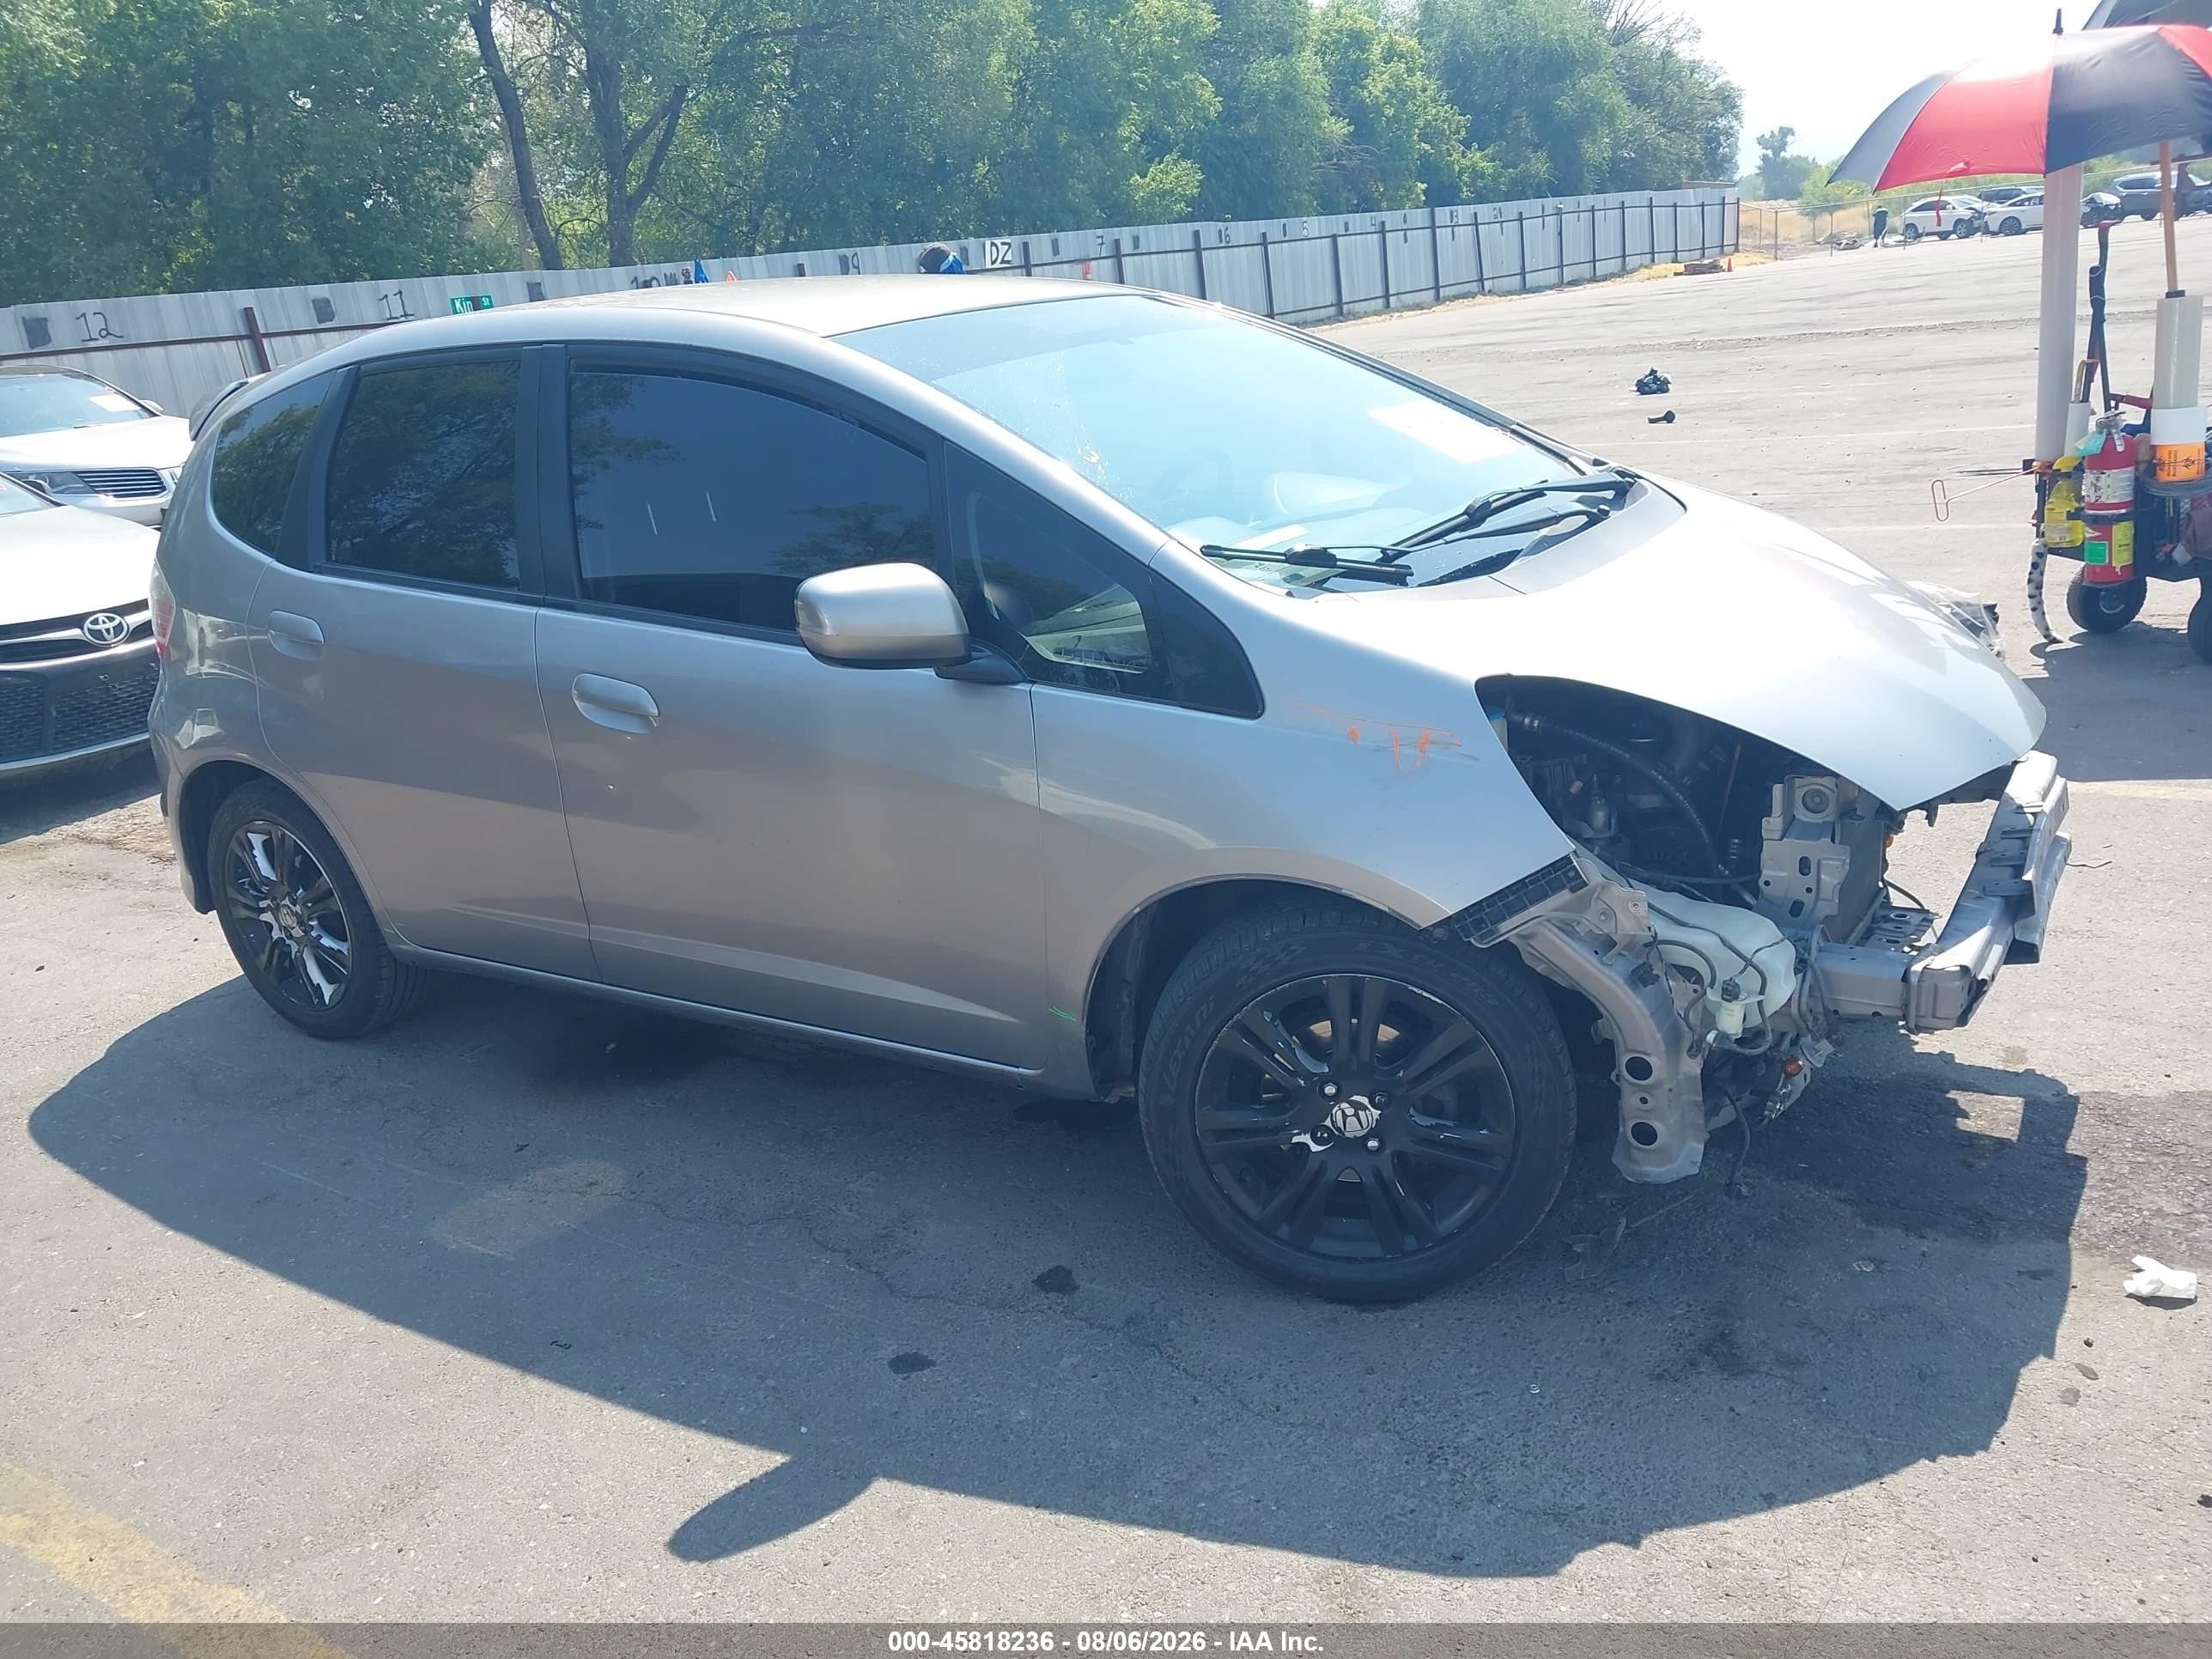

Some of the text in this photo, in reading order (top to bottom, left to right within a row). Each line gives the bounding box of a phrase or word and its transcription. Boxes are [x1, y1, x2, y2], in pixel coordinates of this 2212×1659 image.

[1370, 216, 1376, 231] 4
[1454, 210, 1459, 224] 3
[1224, 227, 1231, 245] 6
[1302, 221, 1310, 237] 5
[1096, 235, 1105, 256] 7
[378, 289, 415, 320] 11
[454, 298, 475, 313] Kin
[76, 312, 124, 342] 12
